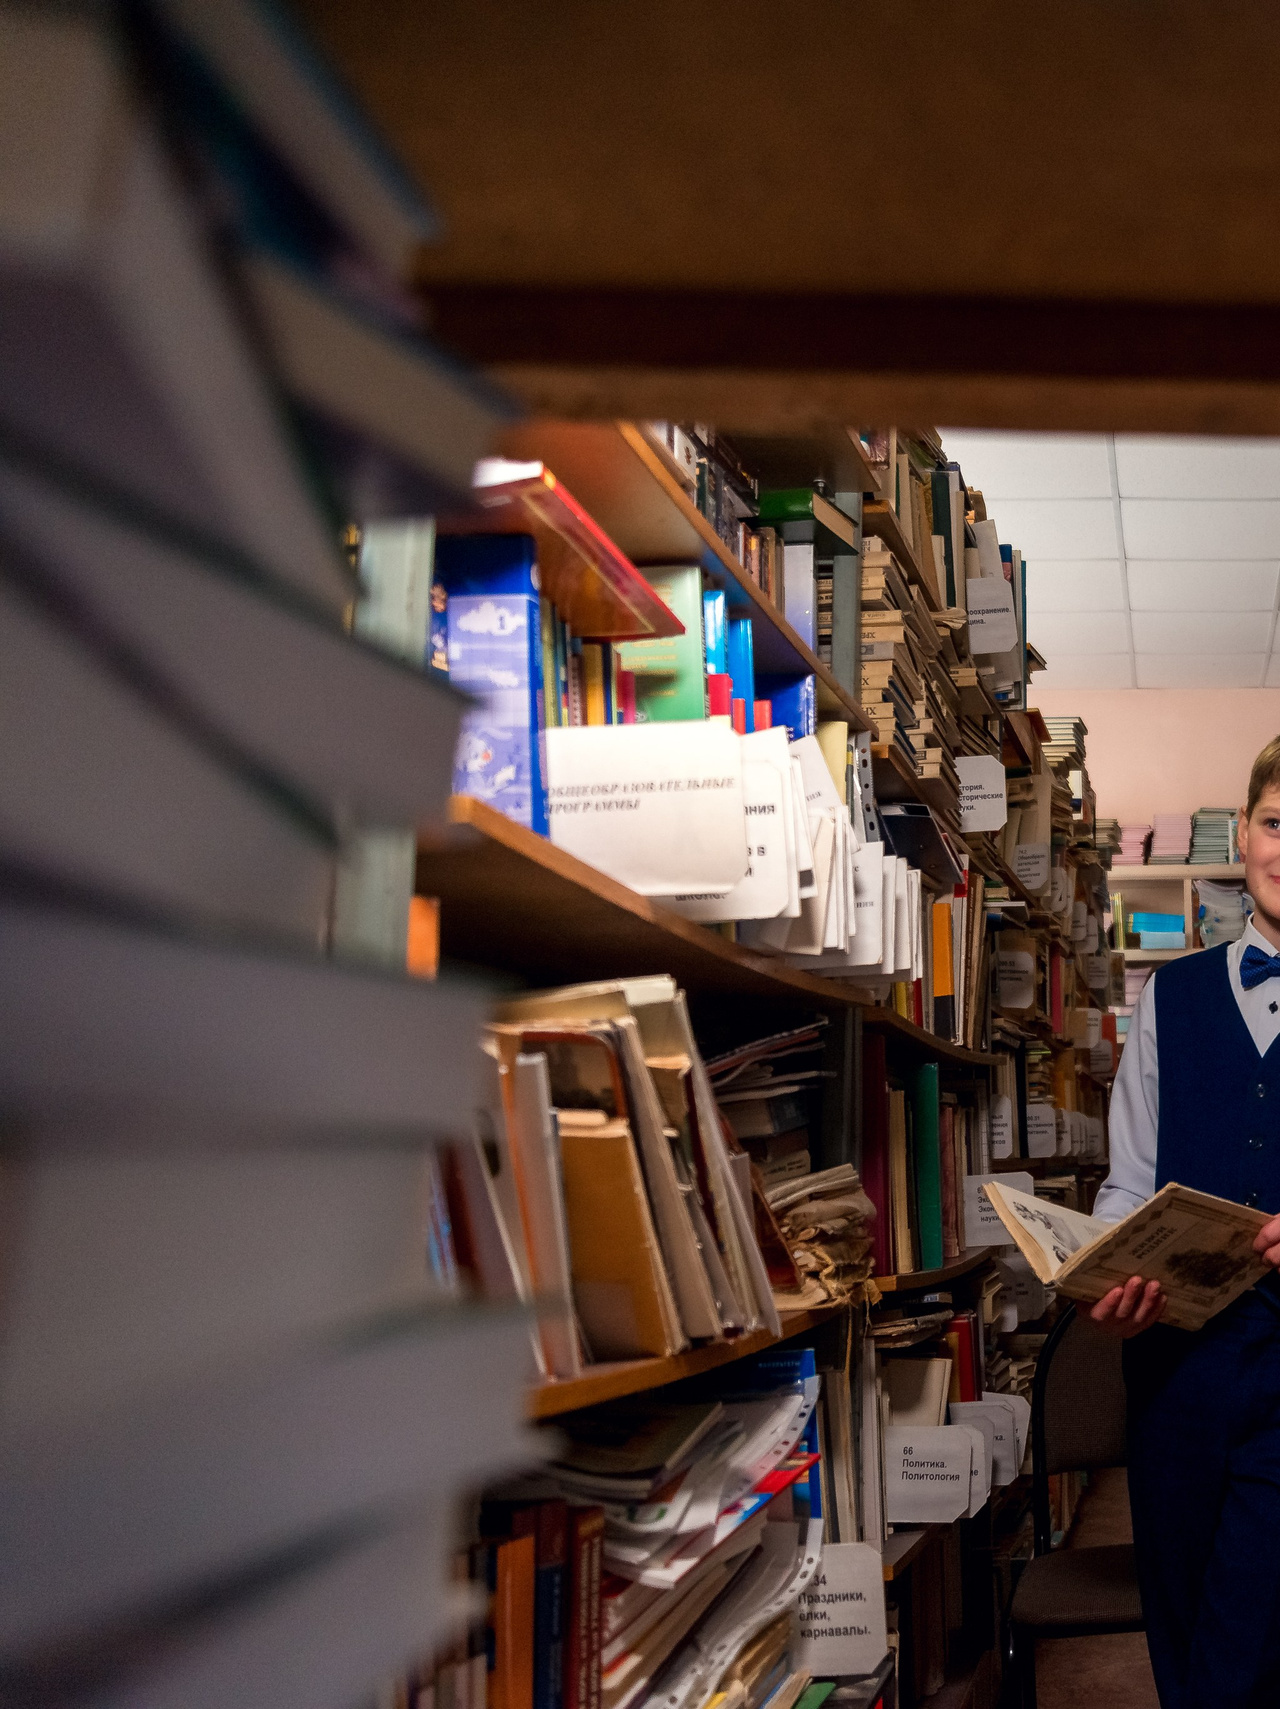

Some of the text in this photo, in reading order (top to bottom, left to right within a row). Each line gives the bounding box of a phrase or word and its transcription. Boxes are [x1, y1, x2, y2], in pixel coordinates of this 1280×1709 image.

[968, 607, 1011, 617] оохранение.
[968, 618, 987, 627] цина.
[978, 1205, 995, 1213] Экон
[902, 1446, 914, 1456] 66
[902, 1459, 948, 1469] Политика.
[901, 1471, 960, 1481] Политология
[797, 1591, 867, 1606] Праздники,
[800, 1625, 871, 1640] карнавалы.
